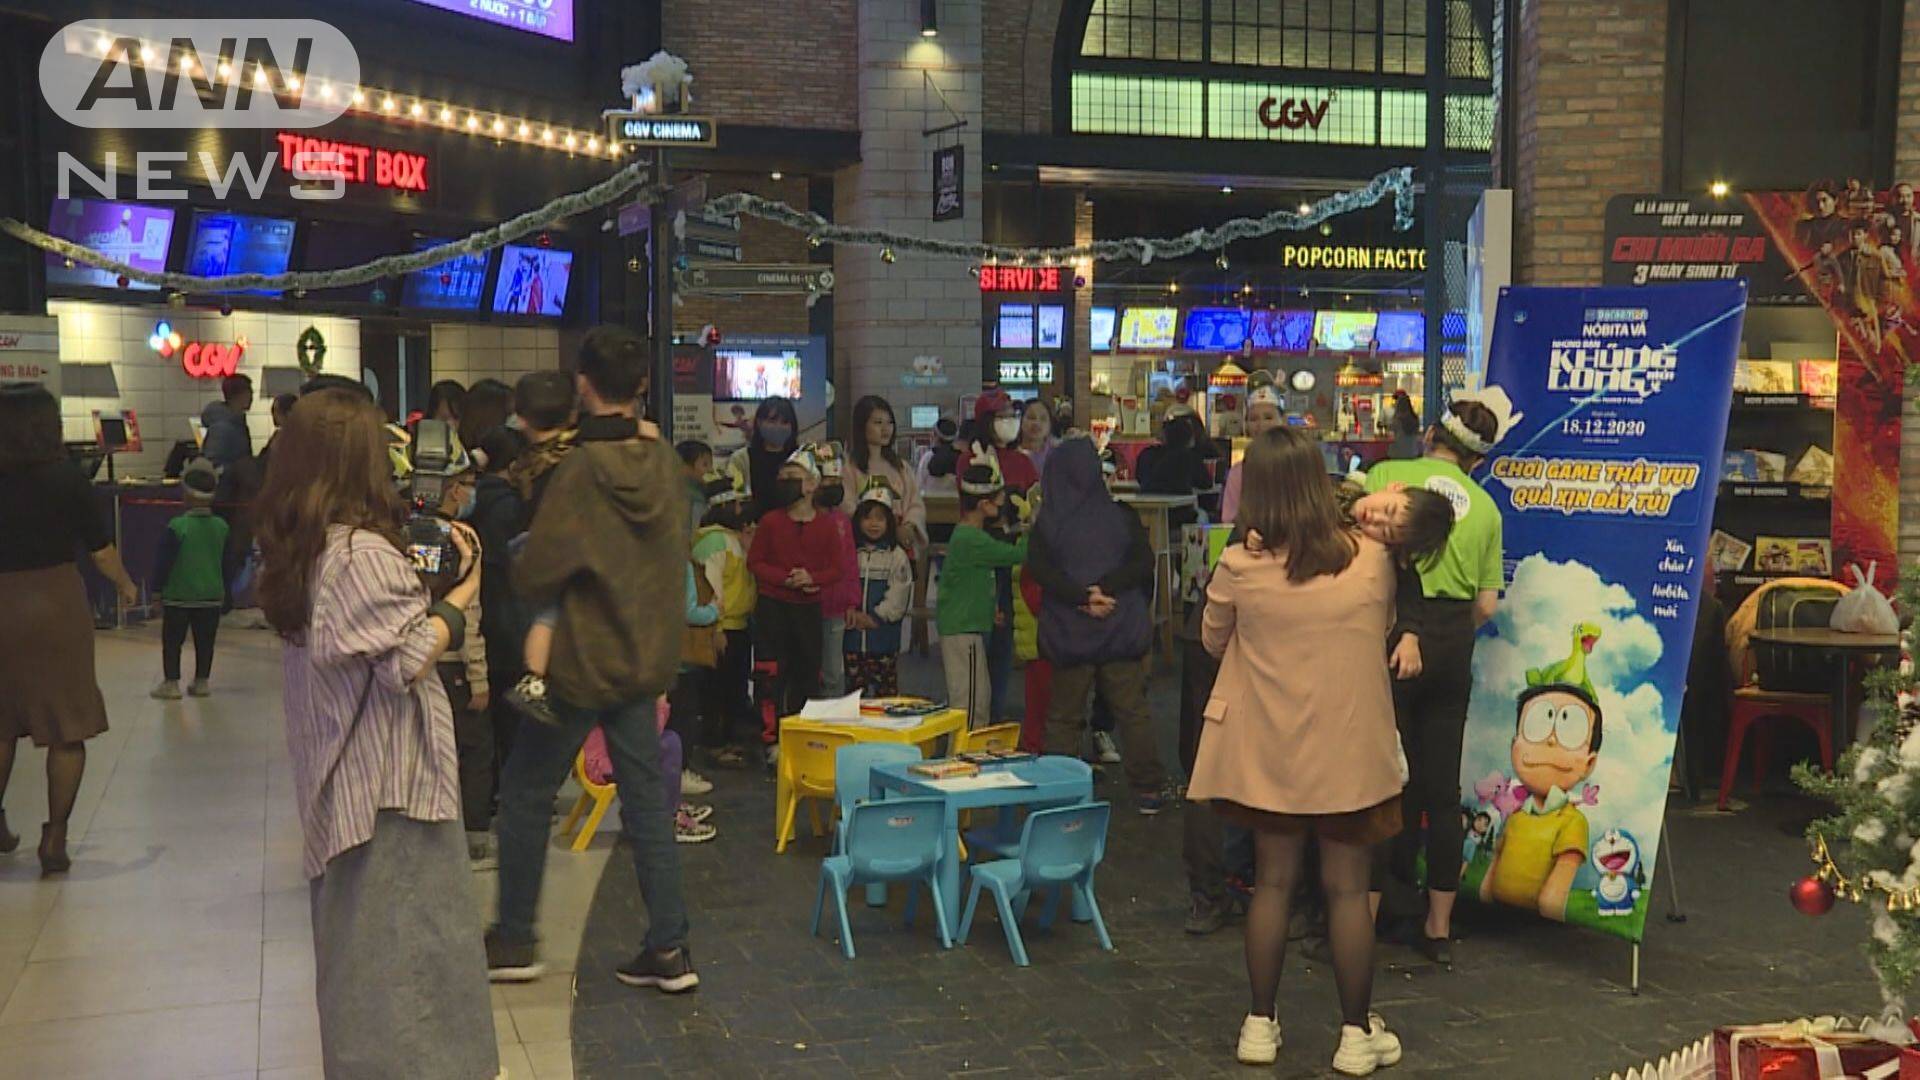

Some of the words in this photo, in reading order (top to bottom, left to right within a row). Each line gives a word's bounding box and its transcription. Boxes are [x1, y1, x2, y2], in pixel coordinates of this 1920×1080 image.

[1259, 97, 1328, 129] CGV
[624, 121, 650, 137] CGV
[653, 122, 701, 139] CINEMA
[277, 132, 369, 183] TICKET
[376, 148, 428, 191] BOX
[1284, 245, 1370, 268] POPCORN
[758, 273, 789, 284] CINEMA
[1633, 264, 1650, 284] 3
[1685, 265, 1719, 278] SINH
[183, 342, 242, 377] CGV
[1562, 419, 1646, 437] 18.12.2020
[1547, 462, 1601, 482] GAME
[1658, 466, 1697, 485] VUI
[1665, 538, 1685, 554] Xin
